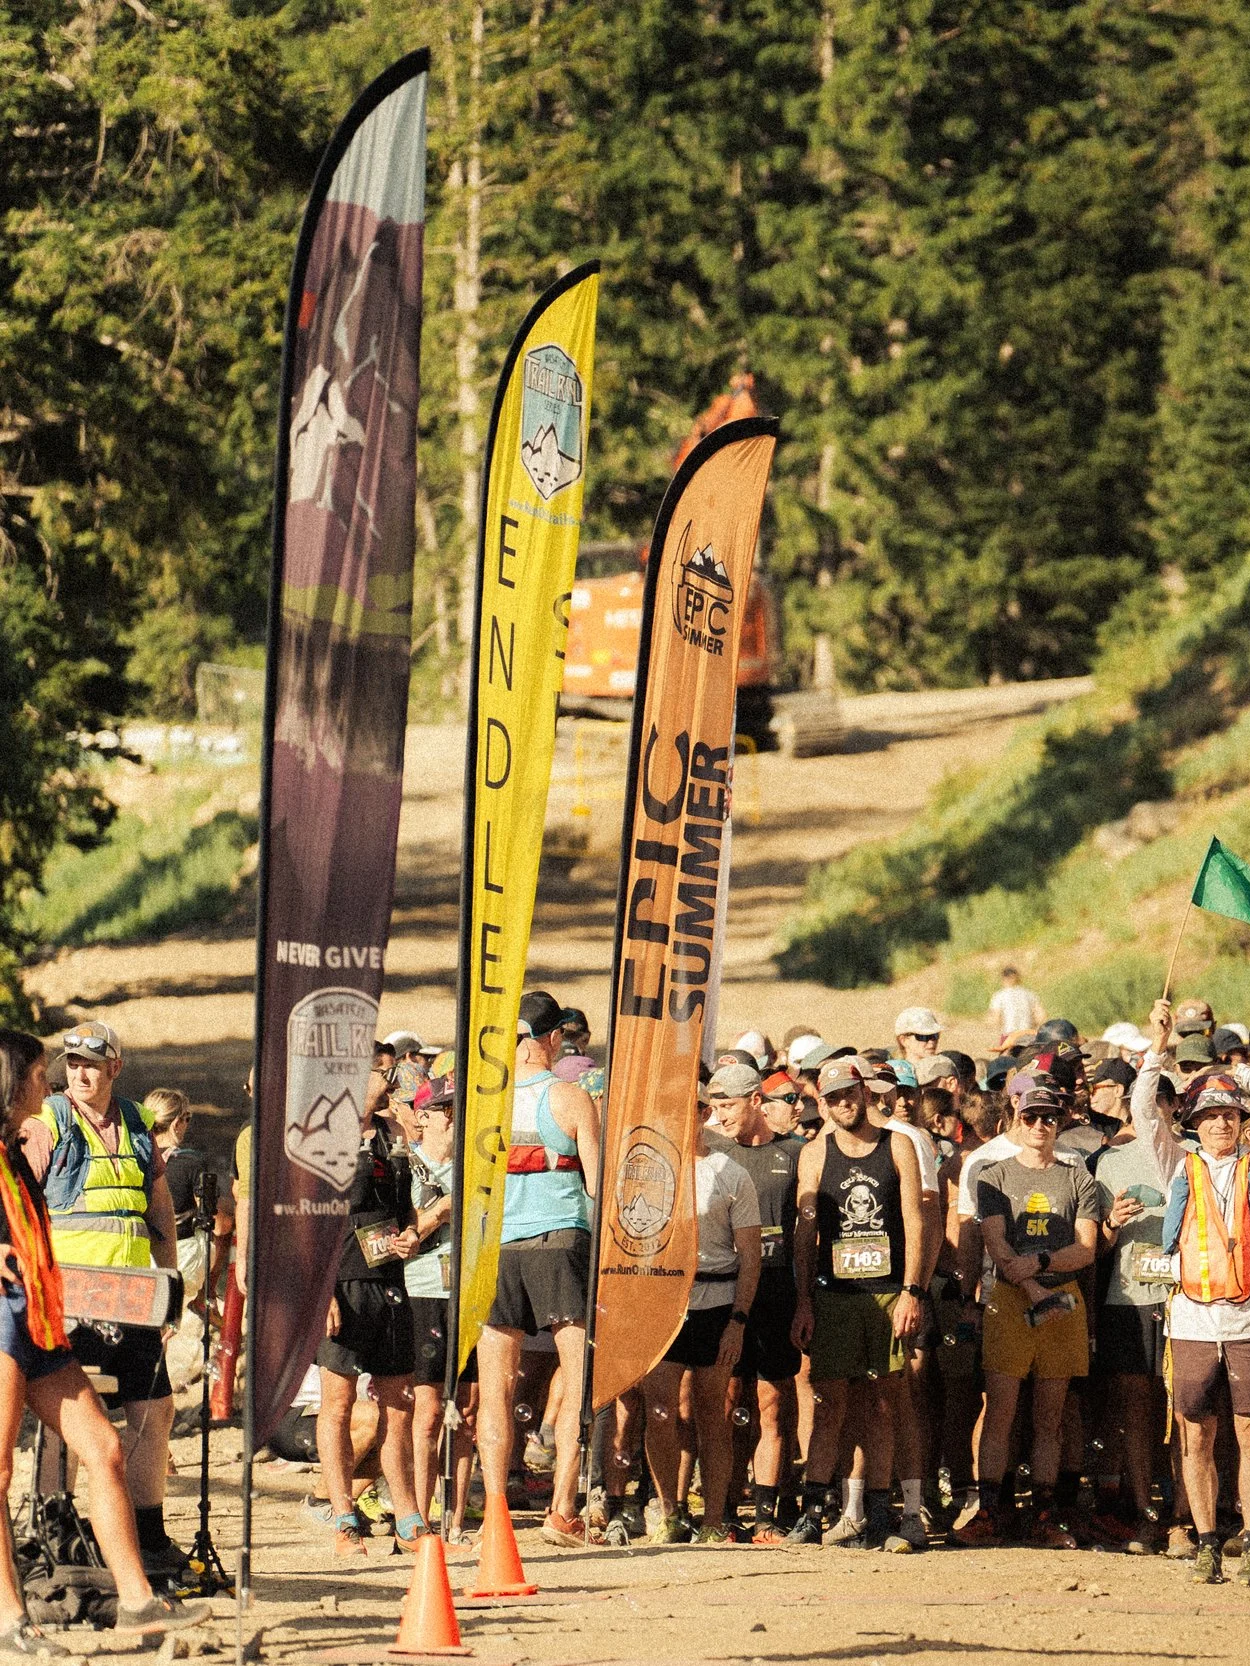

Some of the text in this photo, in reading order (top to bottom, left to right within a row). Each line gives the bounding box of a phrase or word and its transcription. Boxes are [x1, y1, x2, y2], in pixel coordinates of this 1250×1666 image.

[526, 358, 583, 405] TRAIL RN
[685, 587, 730, 636] EPIC
[620, 722, 690, 1021] EPIC
[668, 741, 729, 1024] SUMMER
[276, 940, 381, 969] NEVER GIVE
[1026, 1219, 1050, 1237] 5K
[841, 1251, 882, 1268] 7103
[1140, 1257, 1170, 1273] 705
